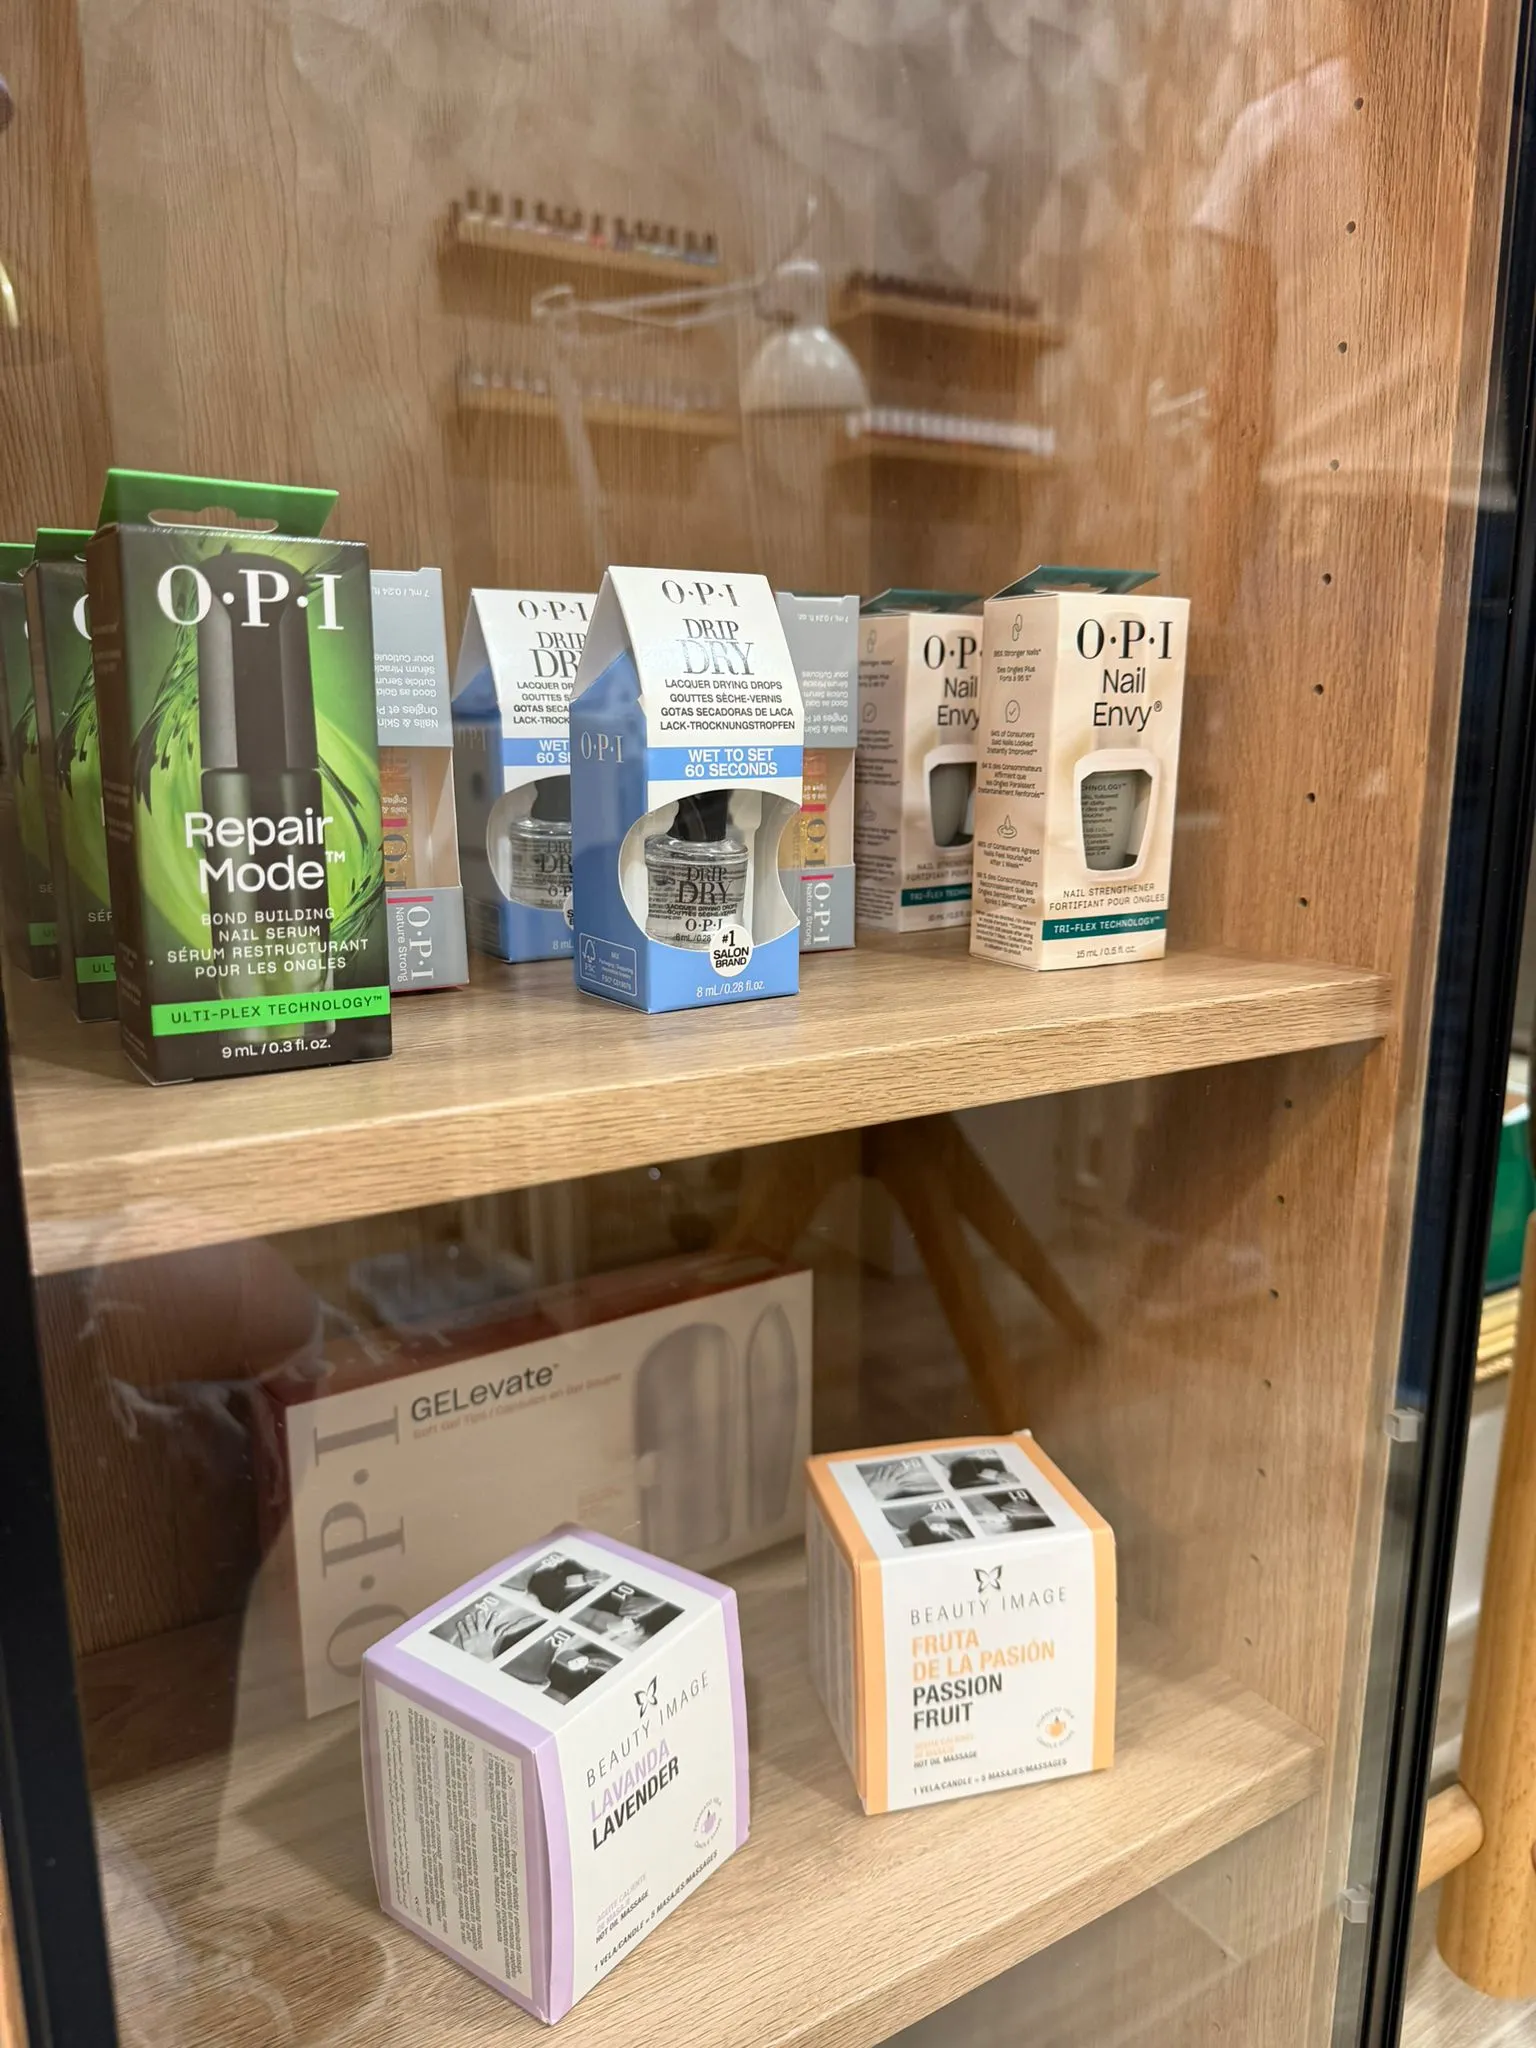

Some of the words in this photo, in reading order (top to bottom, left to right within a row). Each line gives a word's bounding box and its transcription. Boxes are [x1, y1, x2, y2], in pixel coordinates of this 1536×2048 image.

[157, 564, 344, 631] O·P·I
[661, 579, 741, 607] O·P·I
[517, 599, 588, 622] O·P·I
[683, 618, 740, 641] DRIP
[1076, 618, 1173, 660] O·P·I
[414, 654, 434, 663] pour
[529, 648, 582, 679] DR
[675, 638, 755, 676] DRY
[405, 664, 436, 676] Sérum
[406, 677, 436, 687] Cuticle
[516, 682, 560, 690] LACQUER
[664, 679, 711, 689] LACQUER
[712, 680, 750, 690] DRYING
[752, 681, 783, 690] DROPS
[943, 677, 978, 698] Nail
[1102, 666, 1146, 694] Nail
[398, 689, 411, 697] as
[413, 688, 437, 698] Good
[521, 693, 563, 702] GOUTTES
[669, 693, 714, 703] GOUTTES
[715, 691, 782, 704] SÈCHE-VERNIS
[388, 704, 400, 715] et
[401, 703, 438, 716] Ongles
[513, 704, 545, 713] GOTAS
[660, 707, 694, 718] GOTAS
[695, 707, 753, 718] SECADORAS
[754, 707, 768, 717] DE
[769, 707, 794, 717] LACA
[377, 717, 400, 727] Skin
[402, 718, 412, 728] &
[413, 717, 439, 728] Nails
[660, 720, 795, 731] LACK-TROCKNUNGSTROPFEN
[539, 739, 569, 752] WET
[580, 730, 625, 764] O·P·I
[688, 748, 721, 762] WET
[724, 748, 745, 762] TO
[747, 747, 774, 761] SET
[536, 752, 555, 764] 60
[684, 763, 705, 777] 60
[708, 762, 778, 777] SECONDS
[184, 807, 333, 855] Repair
[676, 880, 734, 905] DRY
[1063, 889, 1085, 899] NAIL
[1088, 882, 1155, 897] STRENGTHENER
[1049, 898, 1105, 912] FORTIFIANT
[1107, 897, 1131, 908] POUR
[1132, 893, 1165, 906] ONGLES
[201, 912, 247, 926] BOND
[255, 907, 335, 923] BUILDING
[813, 882, 832, 944] O·P·I
[218, 928, 259, 943] NAIL
[265, 925, 321, 940] SERUM
[395, 906, 407, 946] Nature
[1053, 921, 1097, 934] TRI-FLEX
[407, 905, 434, 981] O·P·I
[722, 929, 736, 947] #1
[167, 946, 225, 963] SÉRUM
[232, 938, 369, 959] RESTRUCTURANT
[713, 946, 750, 960] SALON
[195, 965, 240, 979] POUR
[247, 961, 277, 975] LES
[284, 957, 347, 973] ONGLES
[396, 947, 409, 982] Strong
[715, 957, 747, 968] BRAND
[696, 986, 704, 998] 8
[170, 1004, 261, 1024] ULTI-PLEX
[222, 1046, 232, 1059] 9
[235, 1044, 258, 1057] mL
[269, 1041, 293, 1055] 0.3
[929, 1501, 951, 1513] 02
[611, 1582, 636, 1602] 01
[910, 1598, 990, 1626] BEAUTY
[1002, 1586, 1067, 1612] IMAGE
[546, 1629, 570, 1649] 02
[911, 1628, 980, 1658] FRUTA
[913, 1658, 940, 1684] DE
[946, 1653, 974, 1677] LA
[979, 1637, 1055, 1672] PASIÓN
[912, 1672, 1003, 1707] PASSION
[913, 1701, 974, 1731] FRUIT
[586, 1719, 651, 1789] BEAUTY
[659, 1670, 709, 1727] IMAGE
[913, 1759, 928, 1769] HOT
[943, 1750, 977, 1764] MASSAGE
[590, 1737, 670, 1823] LAVANDA
[592, 1755, 680, 1851] LAVENDER
[595, 1929, 608, 1945] HOT
[620, 1889, 650, 1922] MASSAGE
